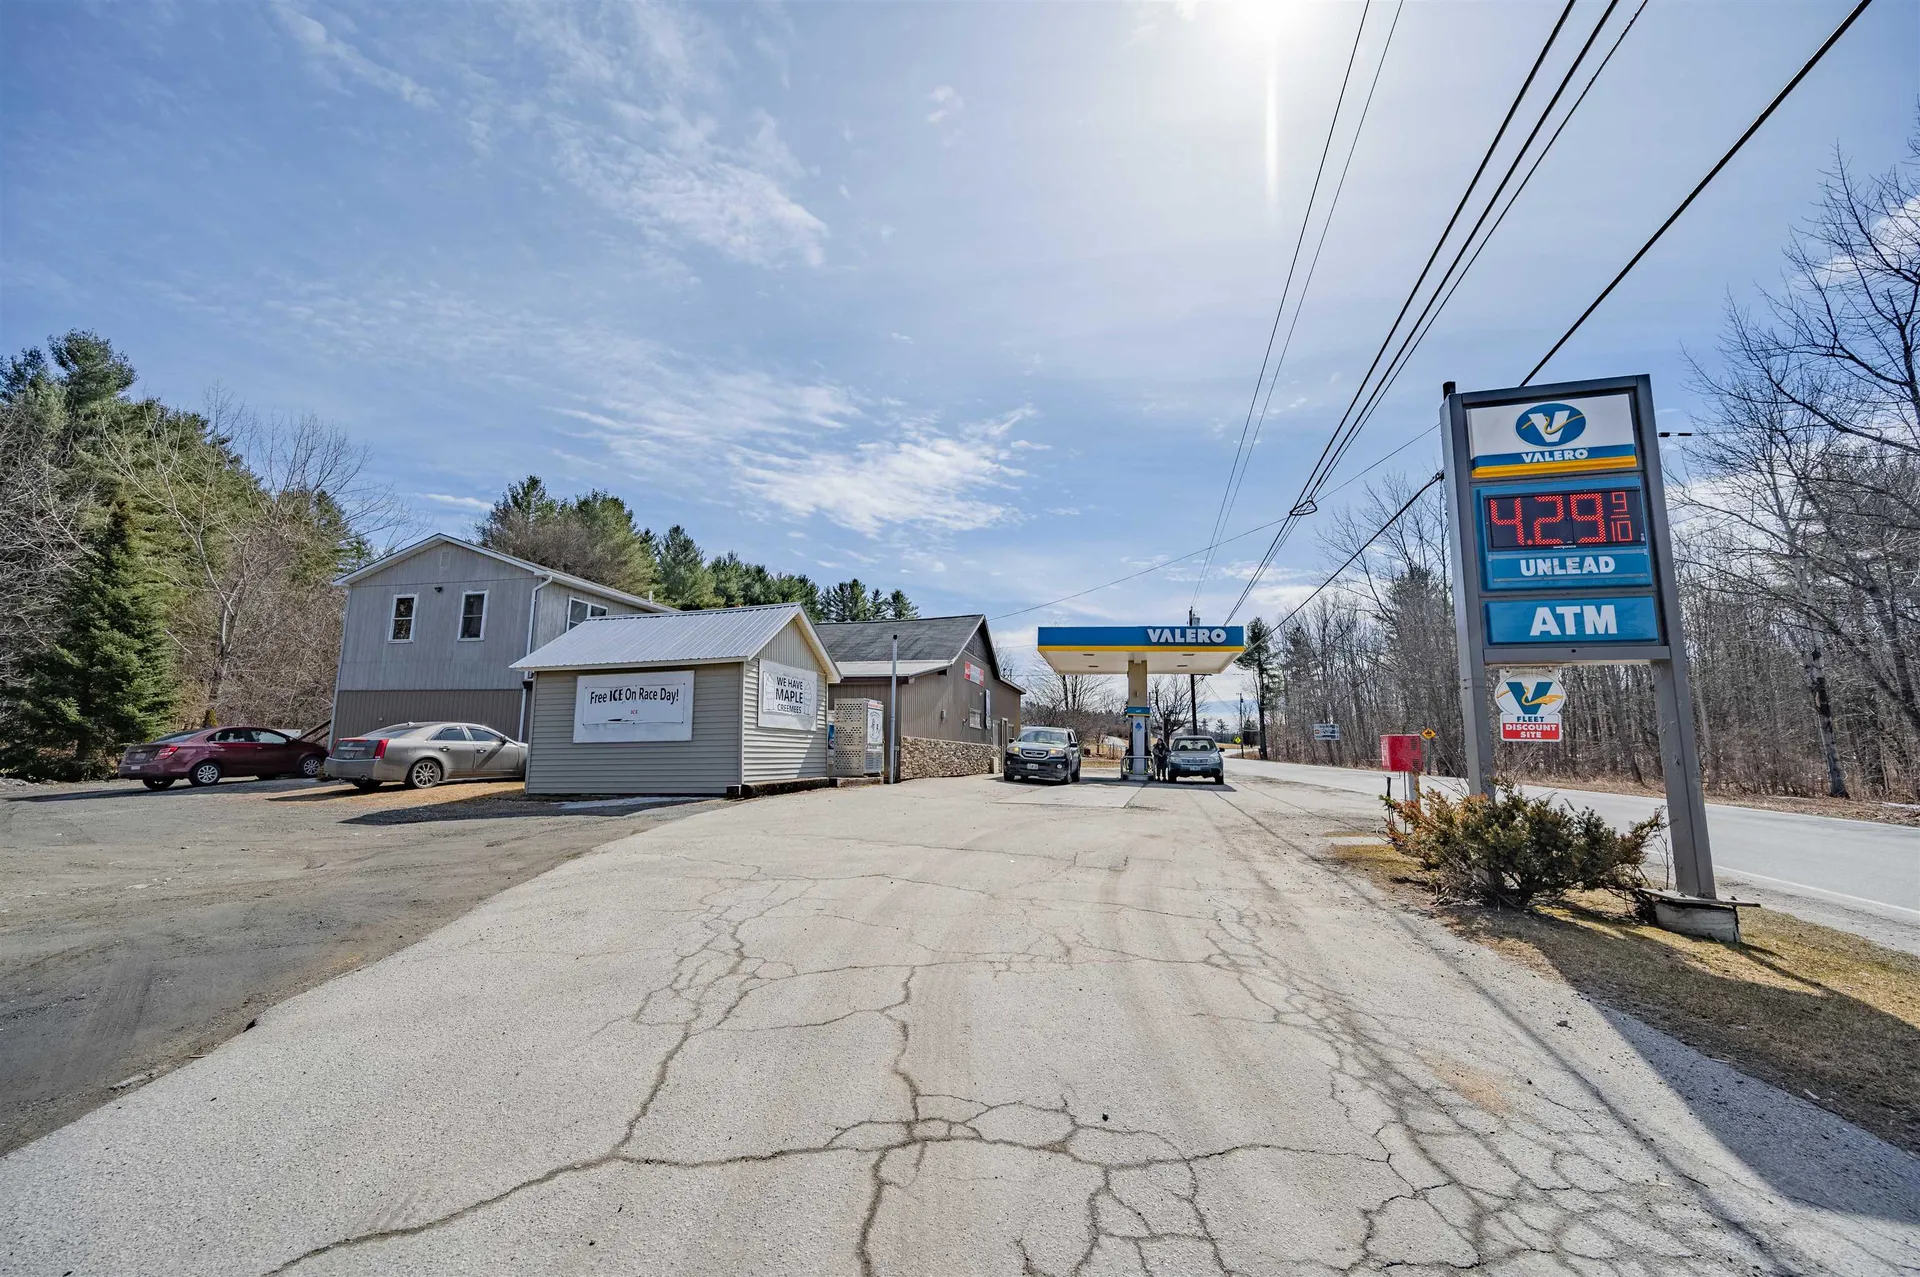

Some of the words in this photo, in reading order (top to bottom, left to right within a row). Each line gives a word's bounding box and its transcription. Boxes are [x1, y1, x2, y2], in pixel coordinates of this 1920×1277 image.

[1521, 449, 1588, 463] VALERO
[1490, 493, 1606, 546] 4.29
[1520, 556, 1616, 576] UNLEAD
[1530, 605, 1618, 636] ATM
[1147, 628, 1227, 643] VALERO
[776, 676, 786, 687] WE
[787, 678, 803, 690] HAVE
[590, 691, 607, 704] Free
[609, 688, 623, 702] ICE
[625, 687, 637, 701] On
[639, 687, 658, 701] Race
[660, 687, 679, 705] Day!
[775, 688, 803, 704] MAPLE
[1520, 731, 1542, 739] SITE
